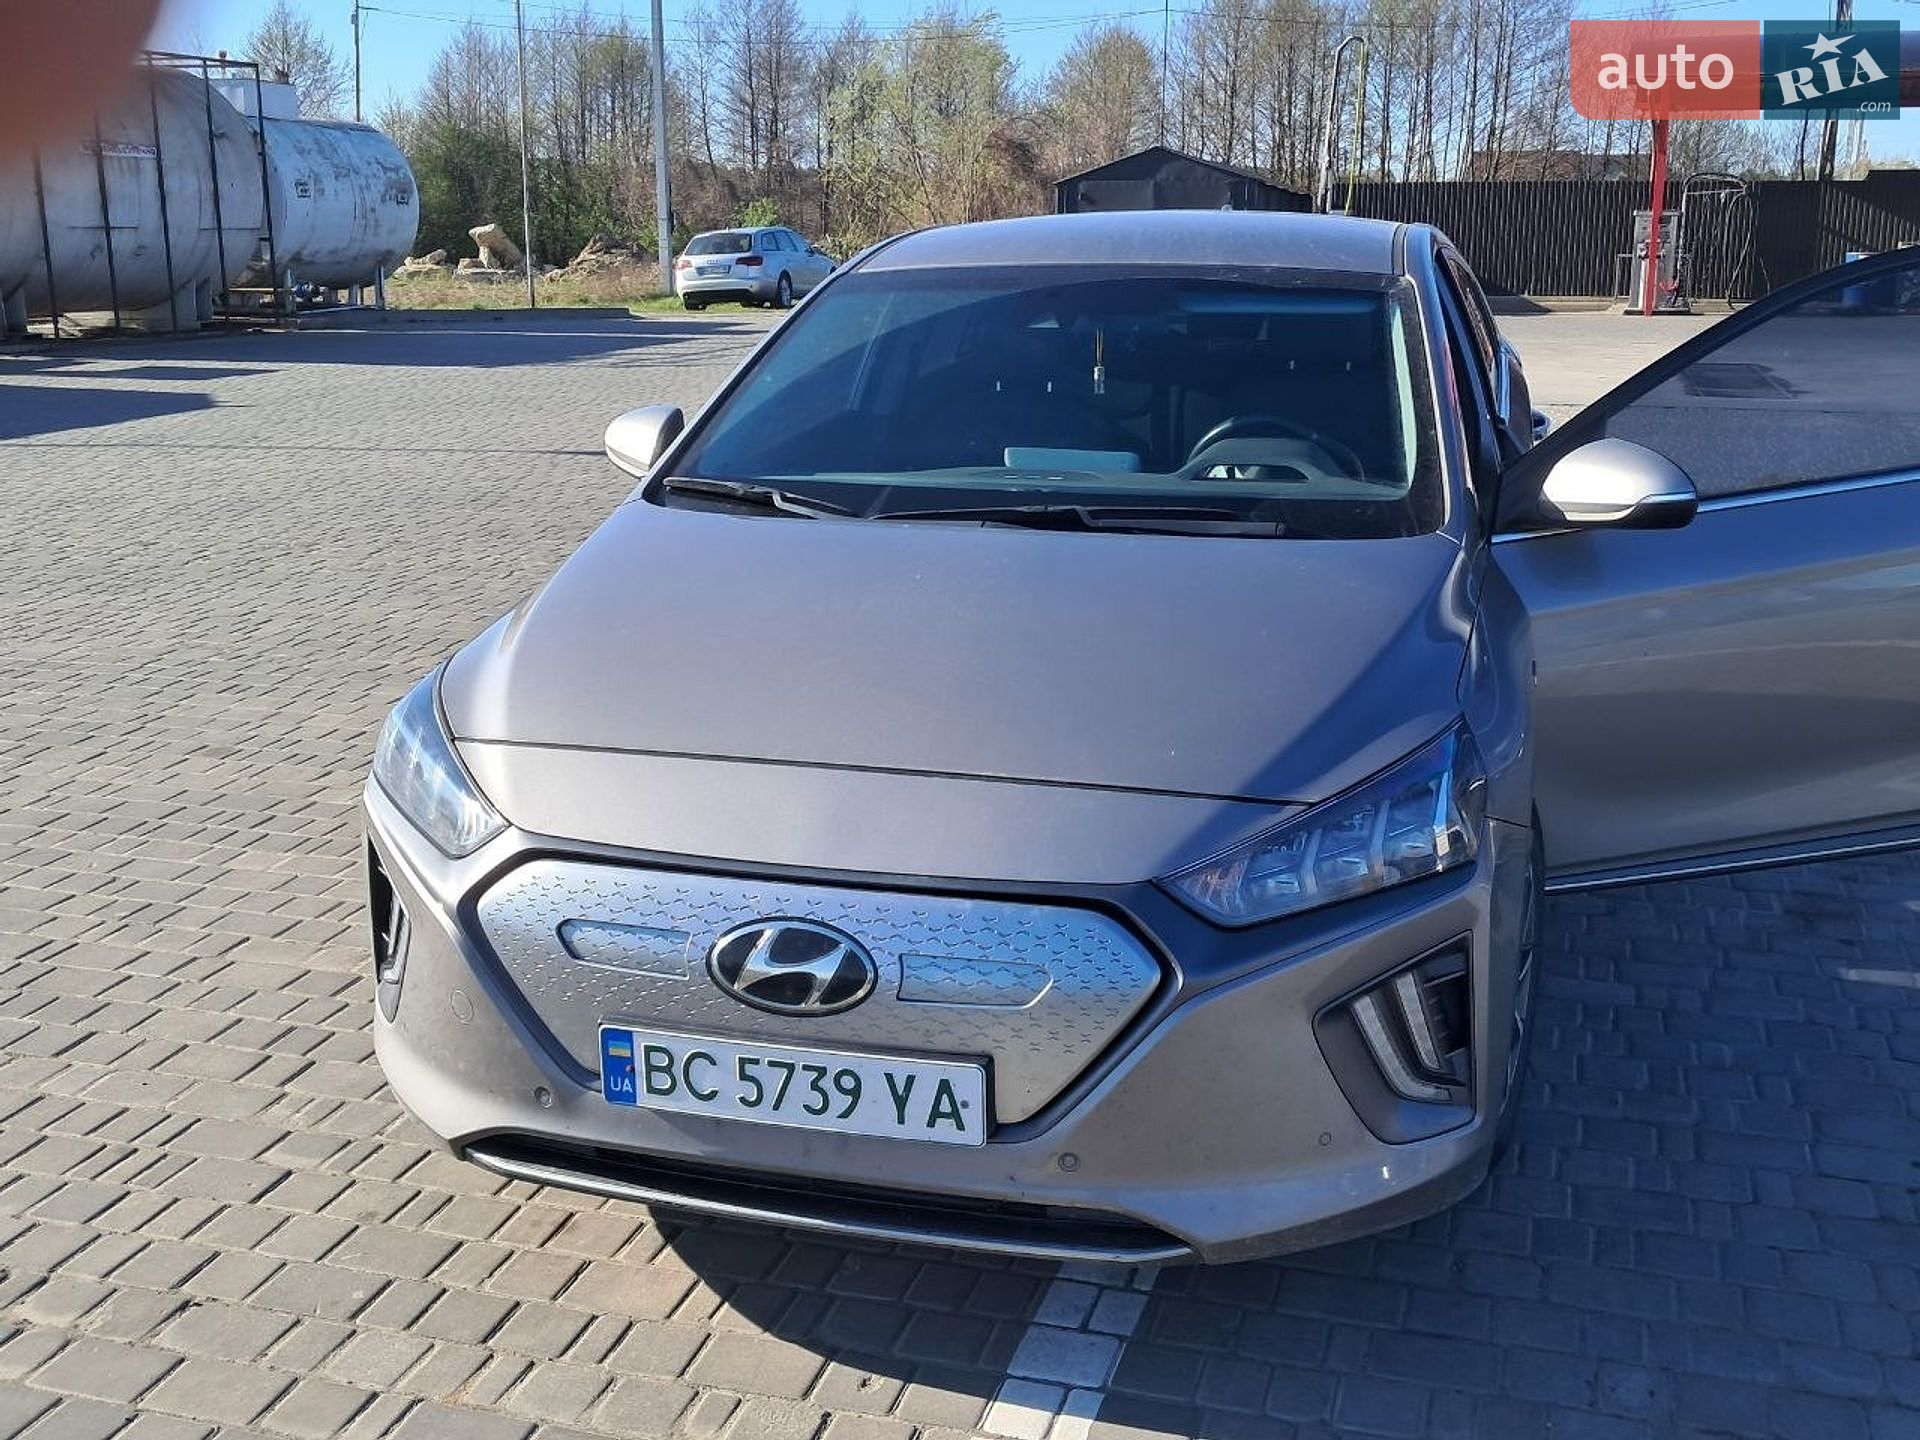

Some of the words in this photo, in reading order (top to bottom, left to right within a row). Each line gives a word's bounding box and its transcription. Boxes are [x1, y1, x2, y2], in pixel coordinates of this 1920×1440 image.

[611, 1077, 633, 1093] UA
[641, 1043, 720, 1101] BC
[735, 1054, 863, 1119] 5739
[884, 1071, 966, 1132] YA
